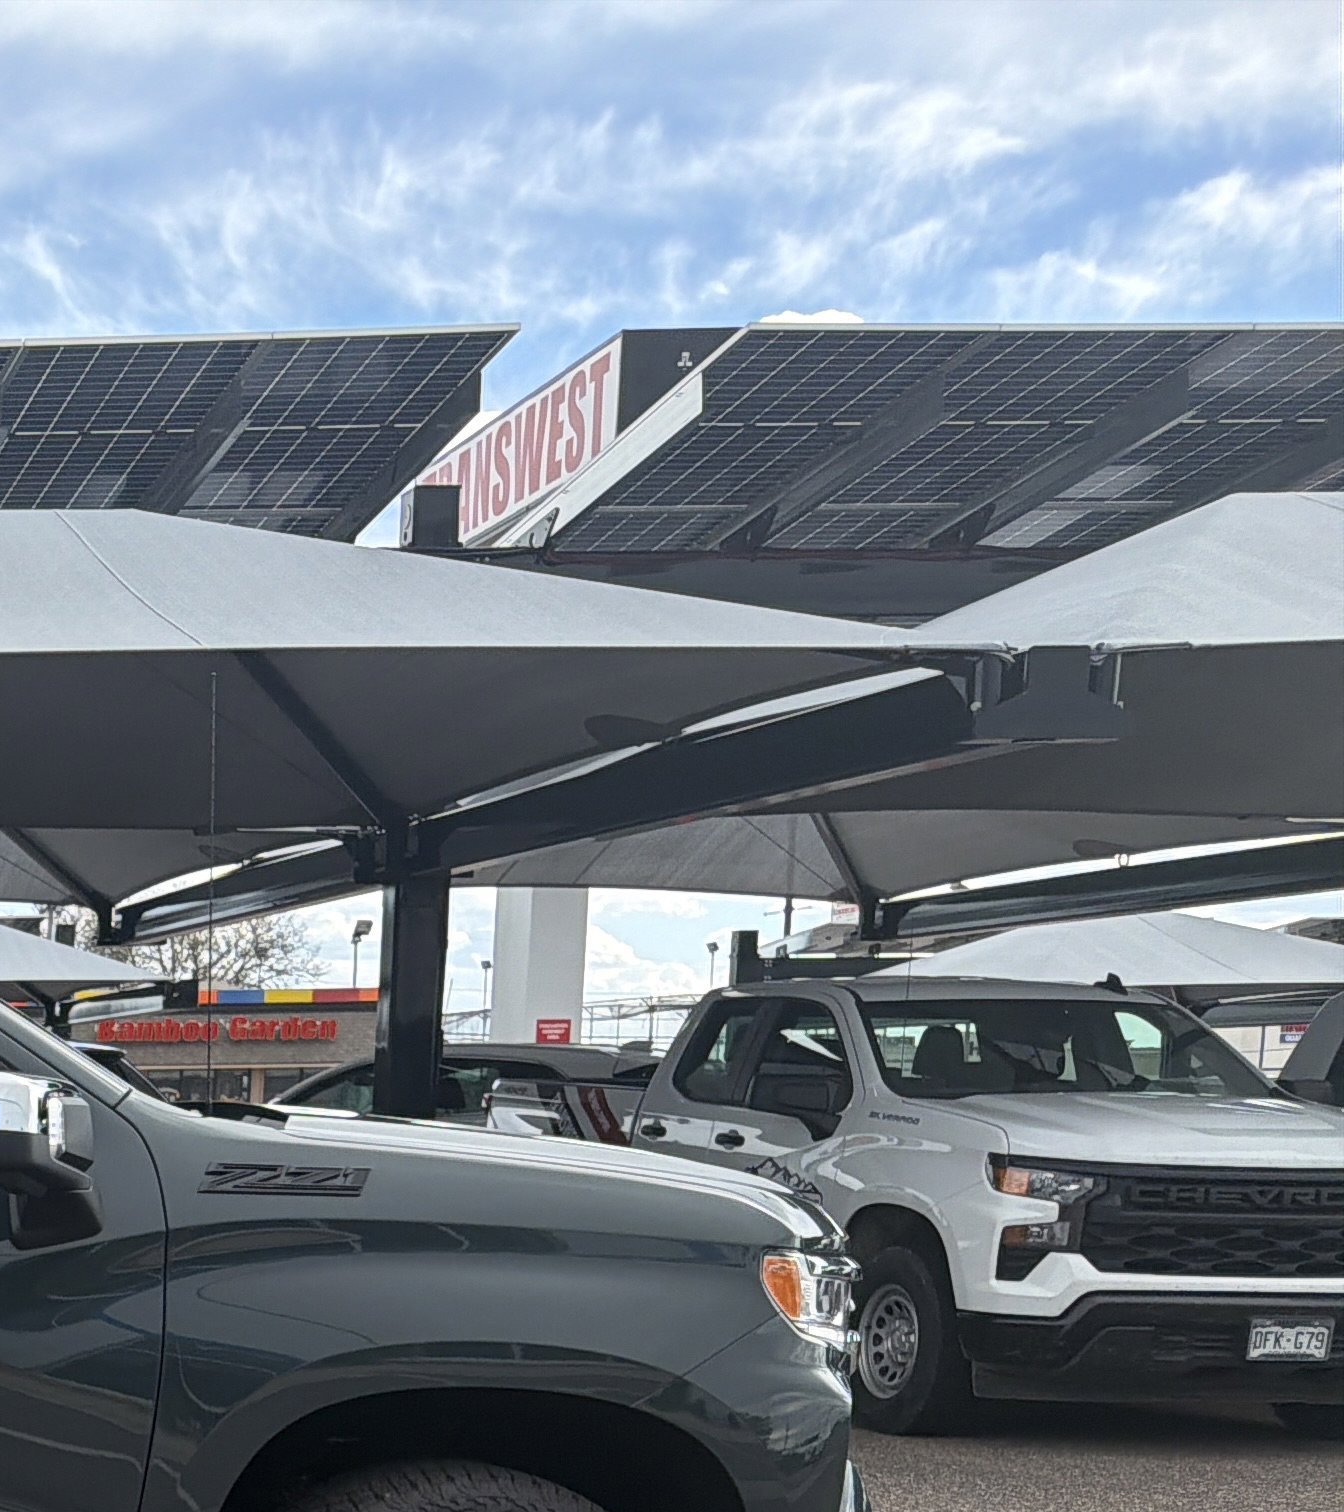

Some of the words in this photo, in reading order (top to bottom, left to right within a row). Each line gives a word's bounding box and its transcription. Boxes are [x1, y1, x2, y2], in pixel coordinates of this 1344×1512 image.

[422, 352, 611, 535] ANSWEST
[96, 1018, 220, 1042] Bamboo
[228, 1015, 338, 1041] Garden
[197, 1161, 372, 1198] Z71
